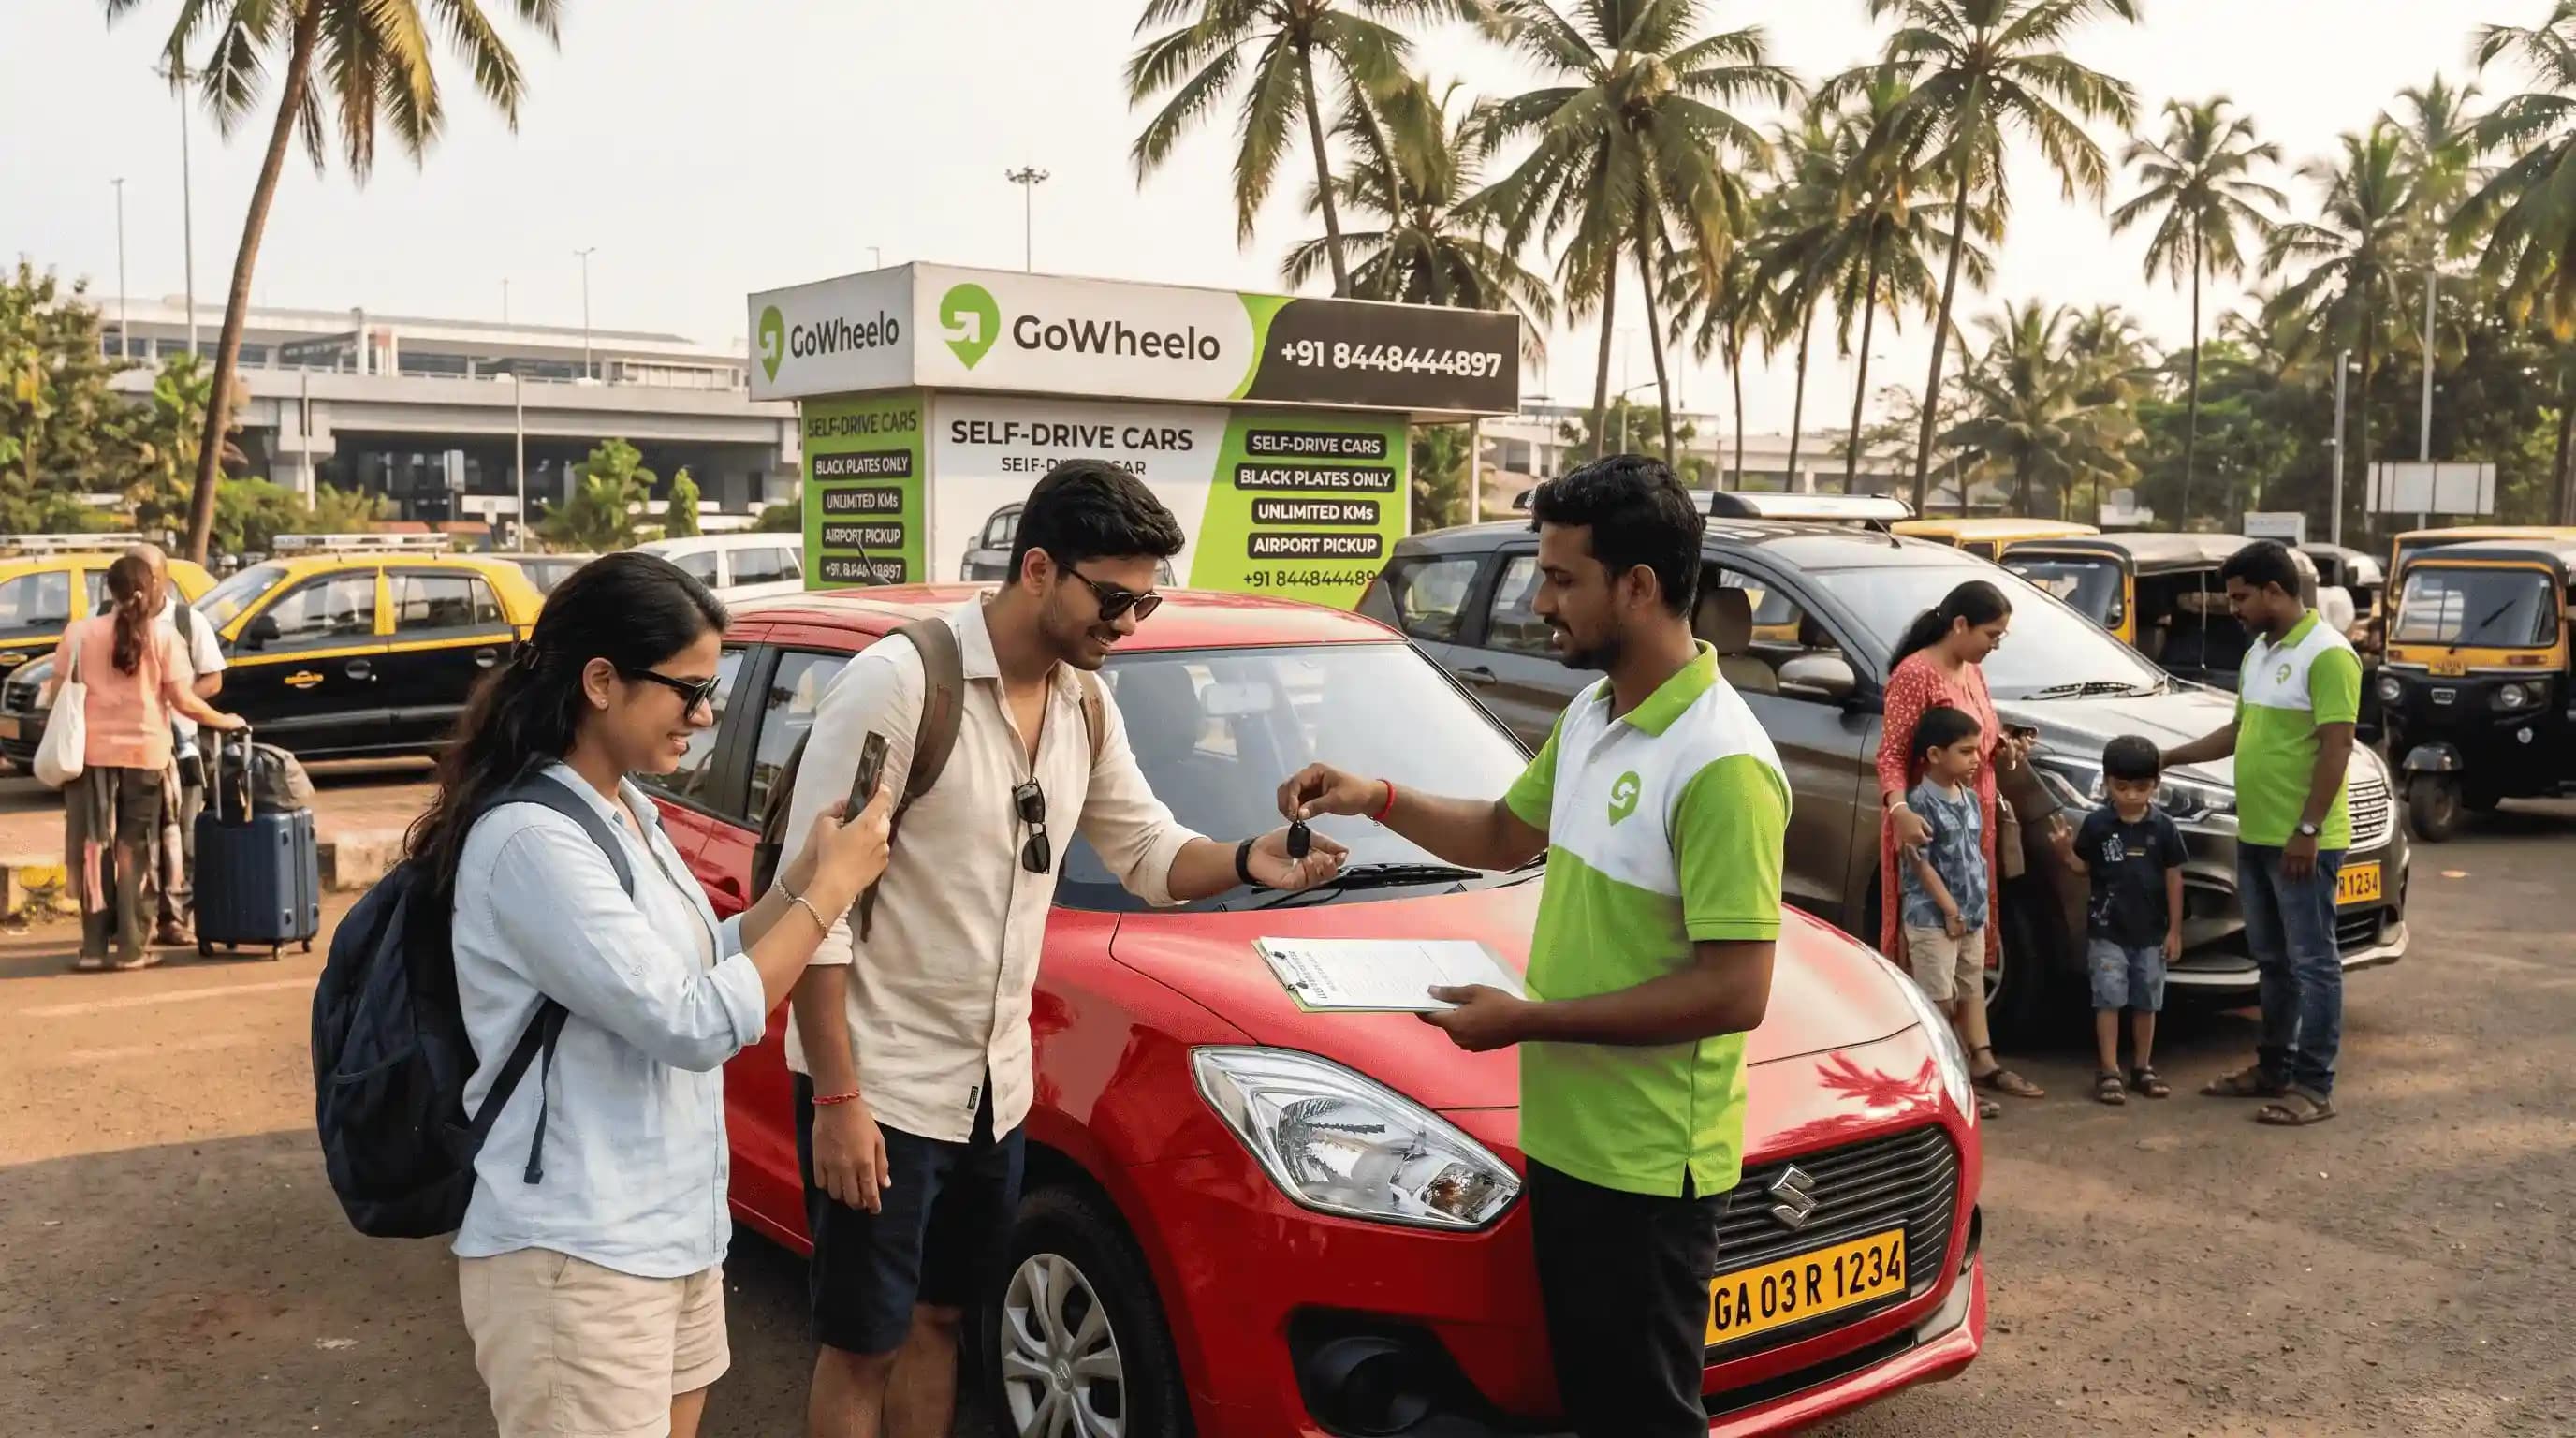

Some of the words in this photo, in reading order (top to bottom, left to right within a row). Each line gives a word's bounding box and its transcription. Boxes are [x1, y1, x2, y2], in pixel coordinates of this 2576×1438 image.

[790, 310, 900, 359] GoWheelo
[1013, 315, 1221, 361] GoWheelo
[1281, 339, 1325, 367] +91
[1333, 342, 1502, 377] 8448444897
[808, 413, 878, 438] SELF-DRIVE
[882, 410, 917, 433] CARS
[951, 420, 1114, 448] SELF-DRIVE
[1122, 427, 1193, 451] CARS
[1252, 435, 1339, 453] SELF-DRIVE
[1341, 438, 1381, 454] CARS
[816, 459, 845, 475] BLACK
[846, 457, 880, 474] PLATES
[882, 456, 908, 472] ONLY
[1240, 469, 1292, 485] BLACK
[1295, 472, 1349, 487] PLATES
[1353, 473, 1391, 487] ONLY
[826, 493, 875, 509] UNLIMITED
[877, 492, 899, 508] KMs
[1258, 504, 1340, 520] UNLIMITED
[1343, 506, 1374, 520] KMs
[825, 528, 864, 543] AIRPORT
[865, 528, 900, 544] PICKUP
[1253, 538, 1321, 553] AIRPORT
[1323, 539, 1378, 554] PICKUP
[1243, 571, 1271, 587] +91
[1276, 570, 1377, 587] 844844489
[2349, 872, 2378, 897] 1234
[1714, 1281, 1752, 1331] GA
[1761, 1270, 1797, 1318] 03
[1806, 1263, 1822, 1307] R
[1833, 1240, 1902, 1299] 1234
